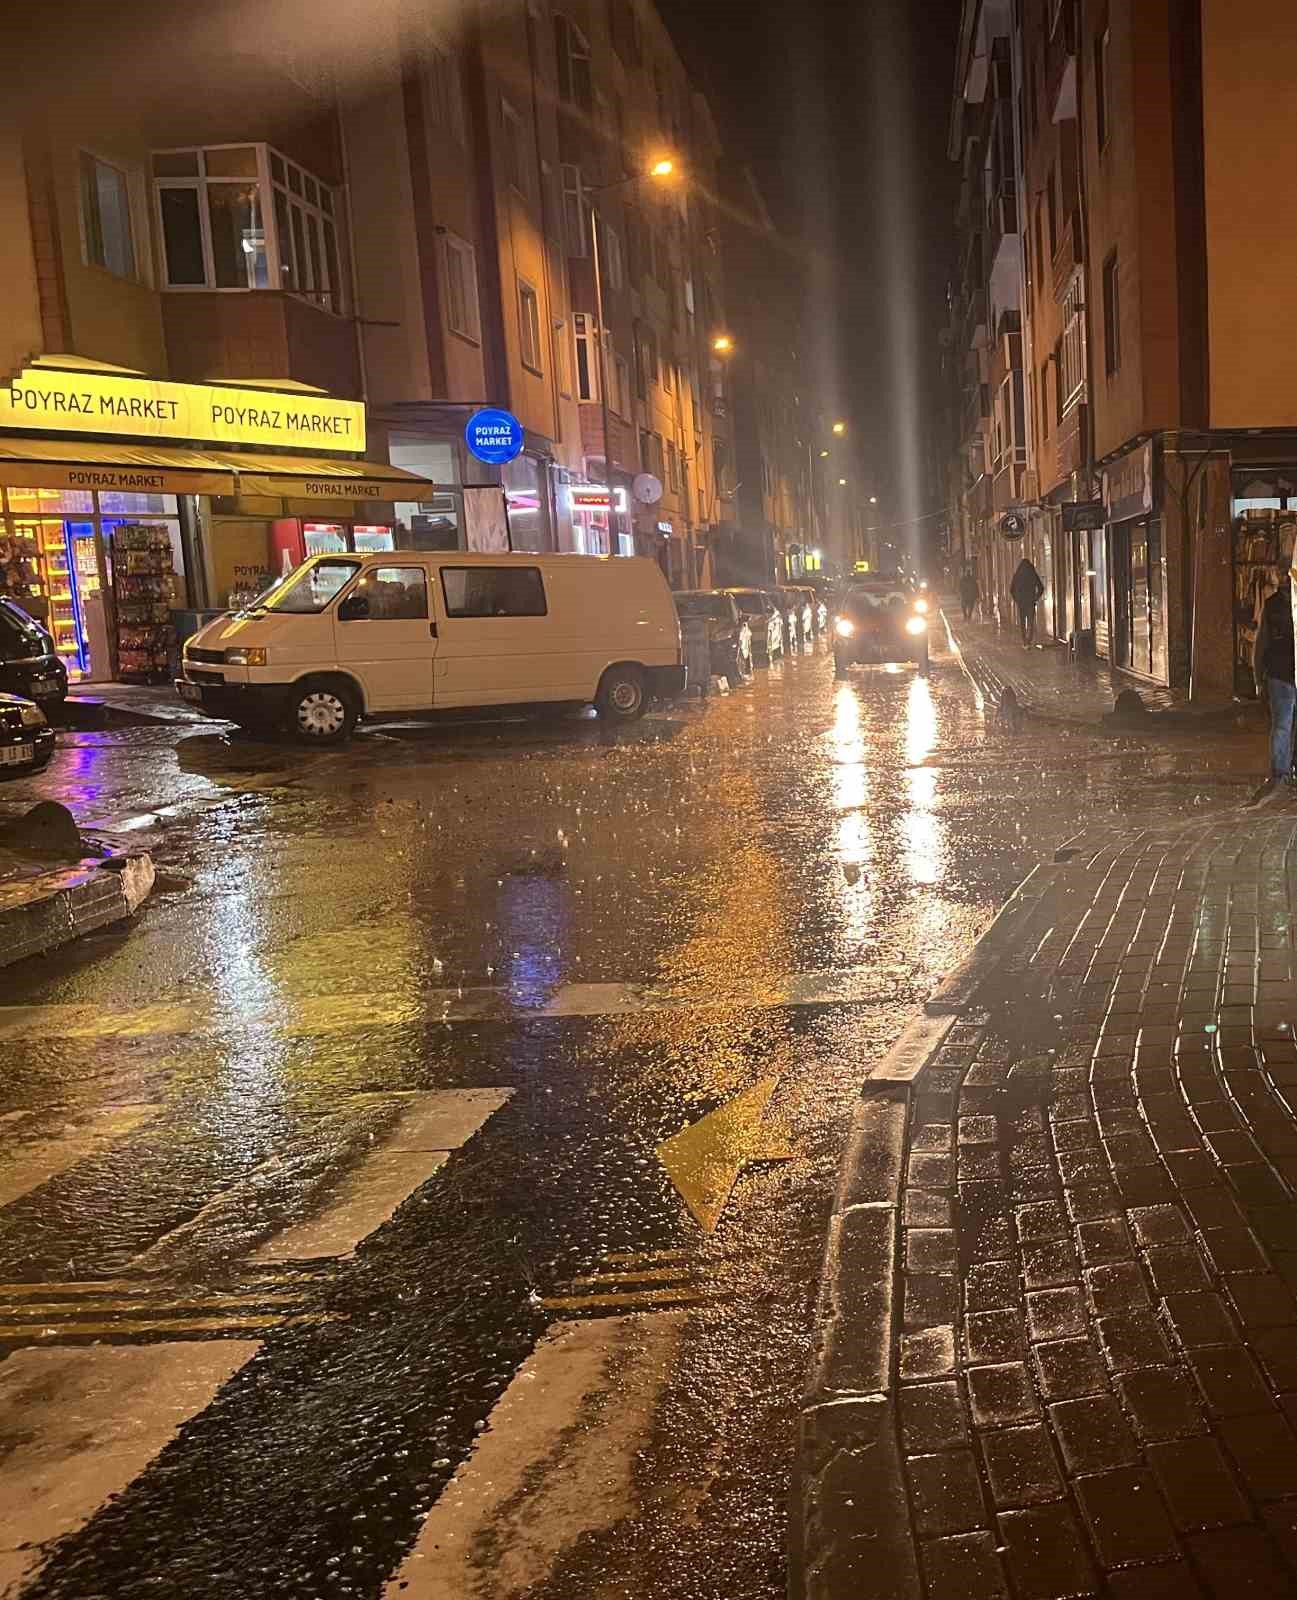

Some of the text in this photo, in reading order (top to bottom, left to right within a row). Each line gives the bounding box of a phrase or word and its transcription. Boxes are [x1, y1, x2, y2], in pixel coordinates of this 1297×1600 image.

[10, 388, 179, 420] POYRAZ MARKET
[211, 405, 353, 434] POYRAZ MARKET
[475, 426, 512, 436] POYRAZ
[476, 436, 513, 446] MARKET
[68, 471, 164, 487] POYRAZ MARKET
[305, 483, 381, 497] POYRAZ MARKET
